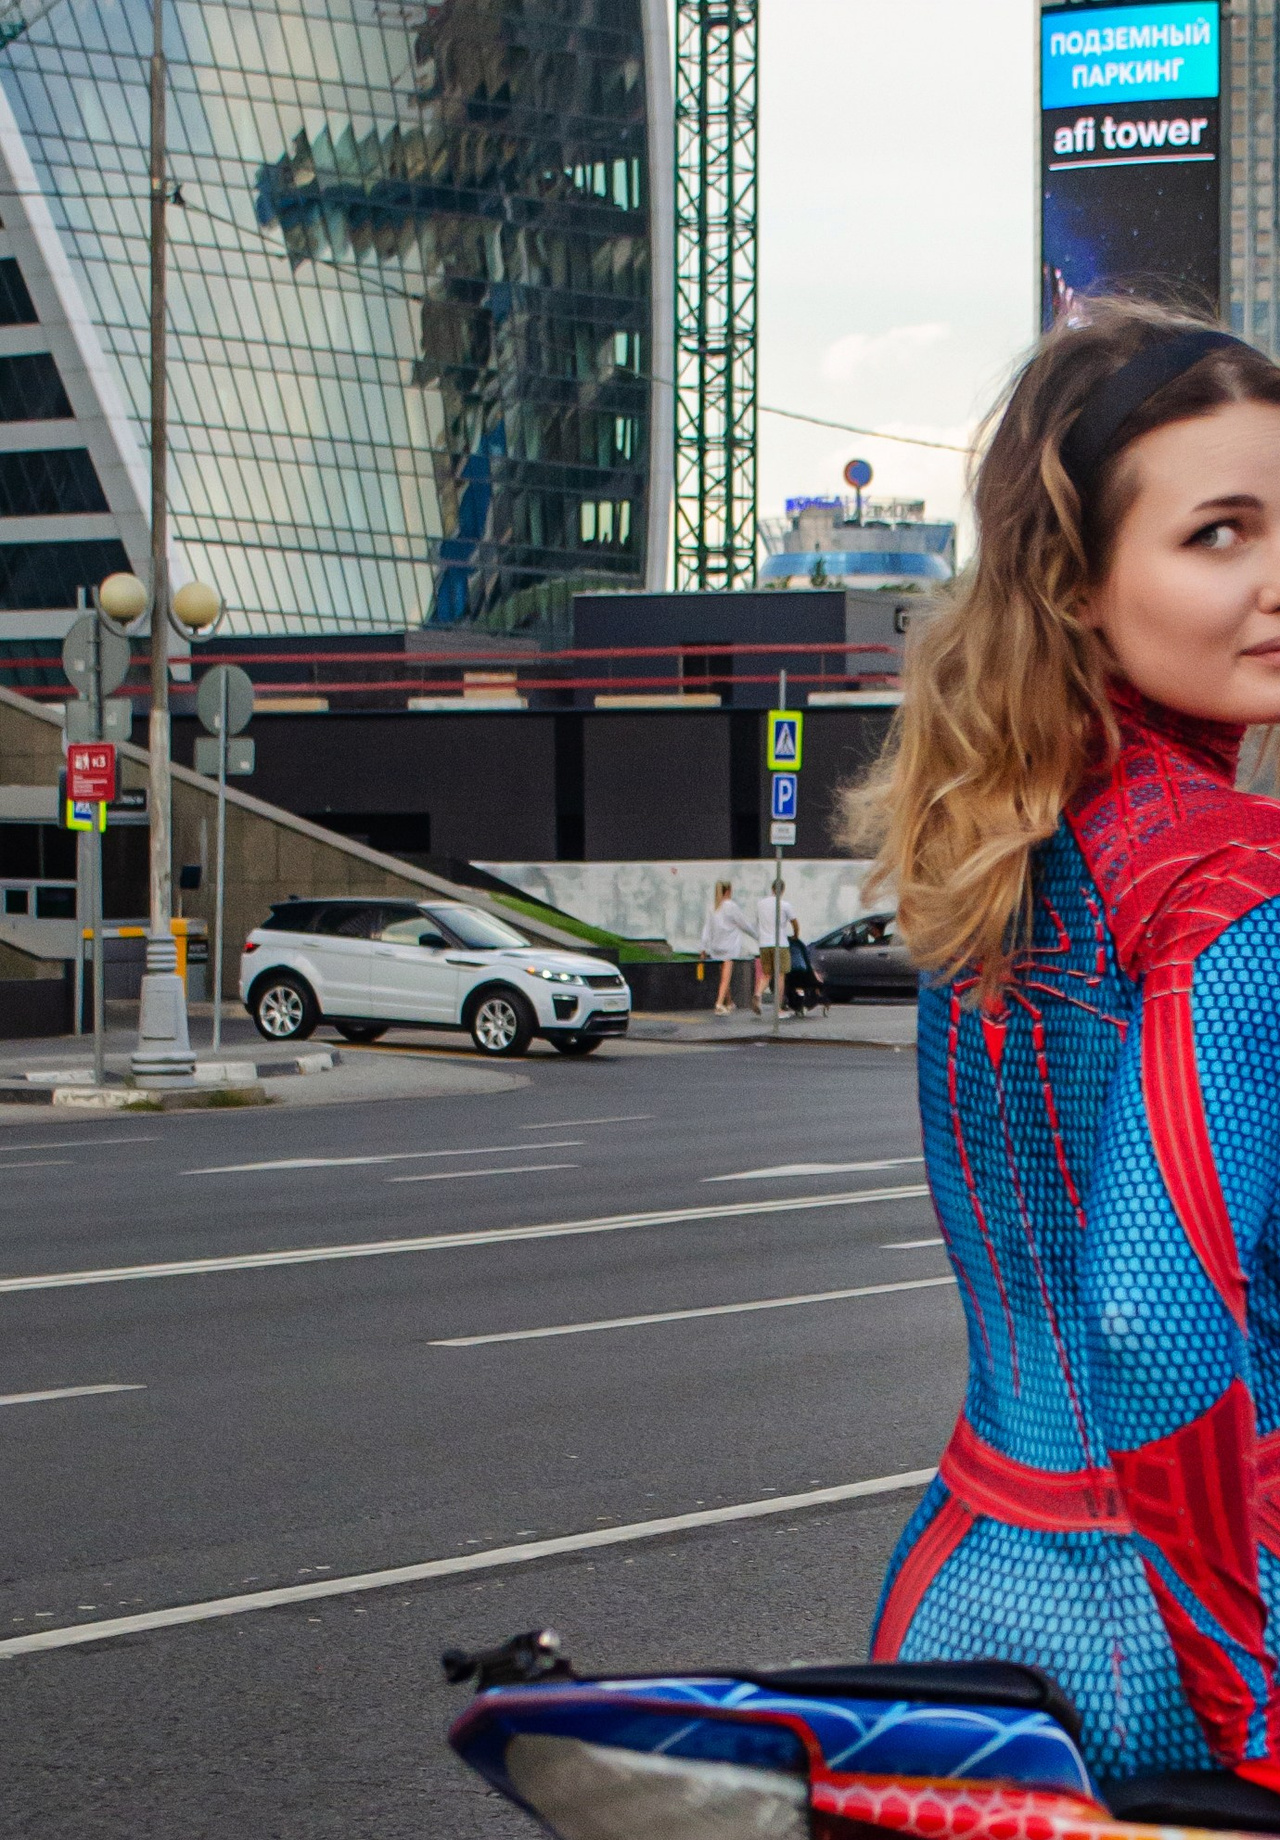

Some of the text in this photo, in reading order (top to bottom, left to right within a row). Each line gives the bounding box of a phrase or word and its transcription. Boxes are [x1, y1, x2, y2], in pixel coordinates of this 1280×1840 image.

[1050, 17, 1211, 57] ПОДЗЕМНЫЙ
[1072, 58, 1185, 89] ПАРКИНГ
[1053, 115, 1209, 154] afi tower
[778, 779, 793, 813] P
